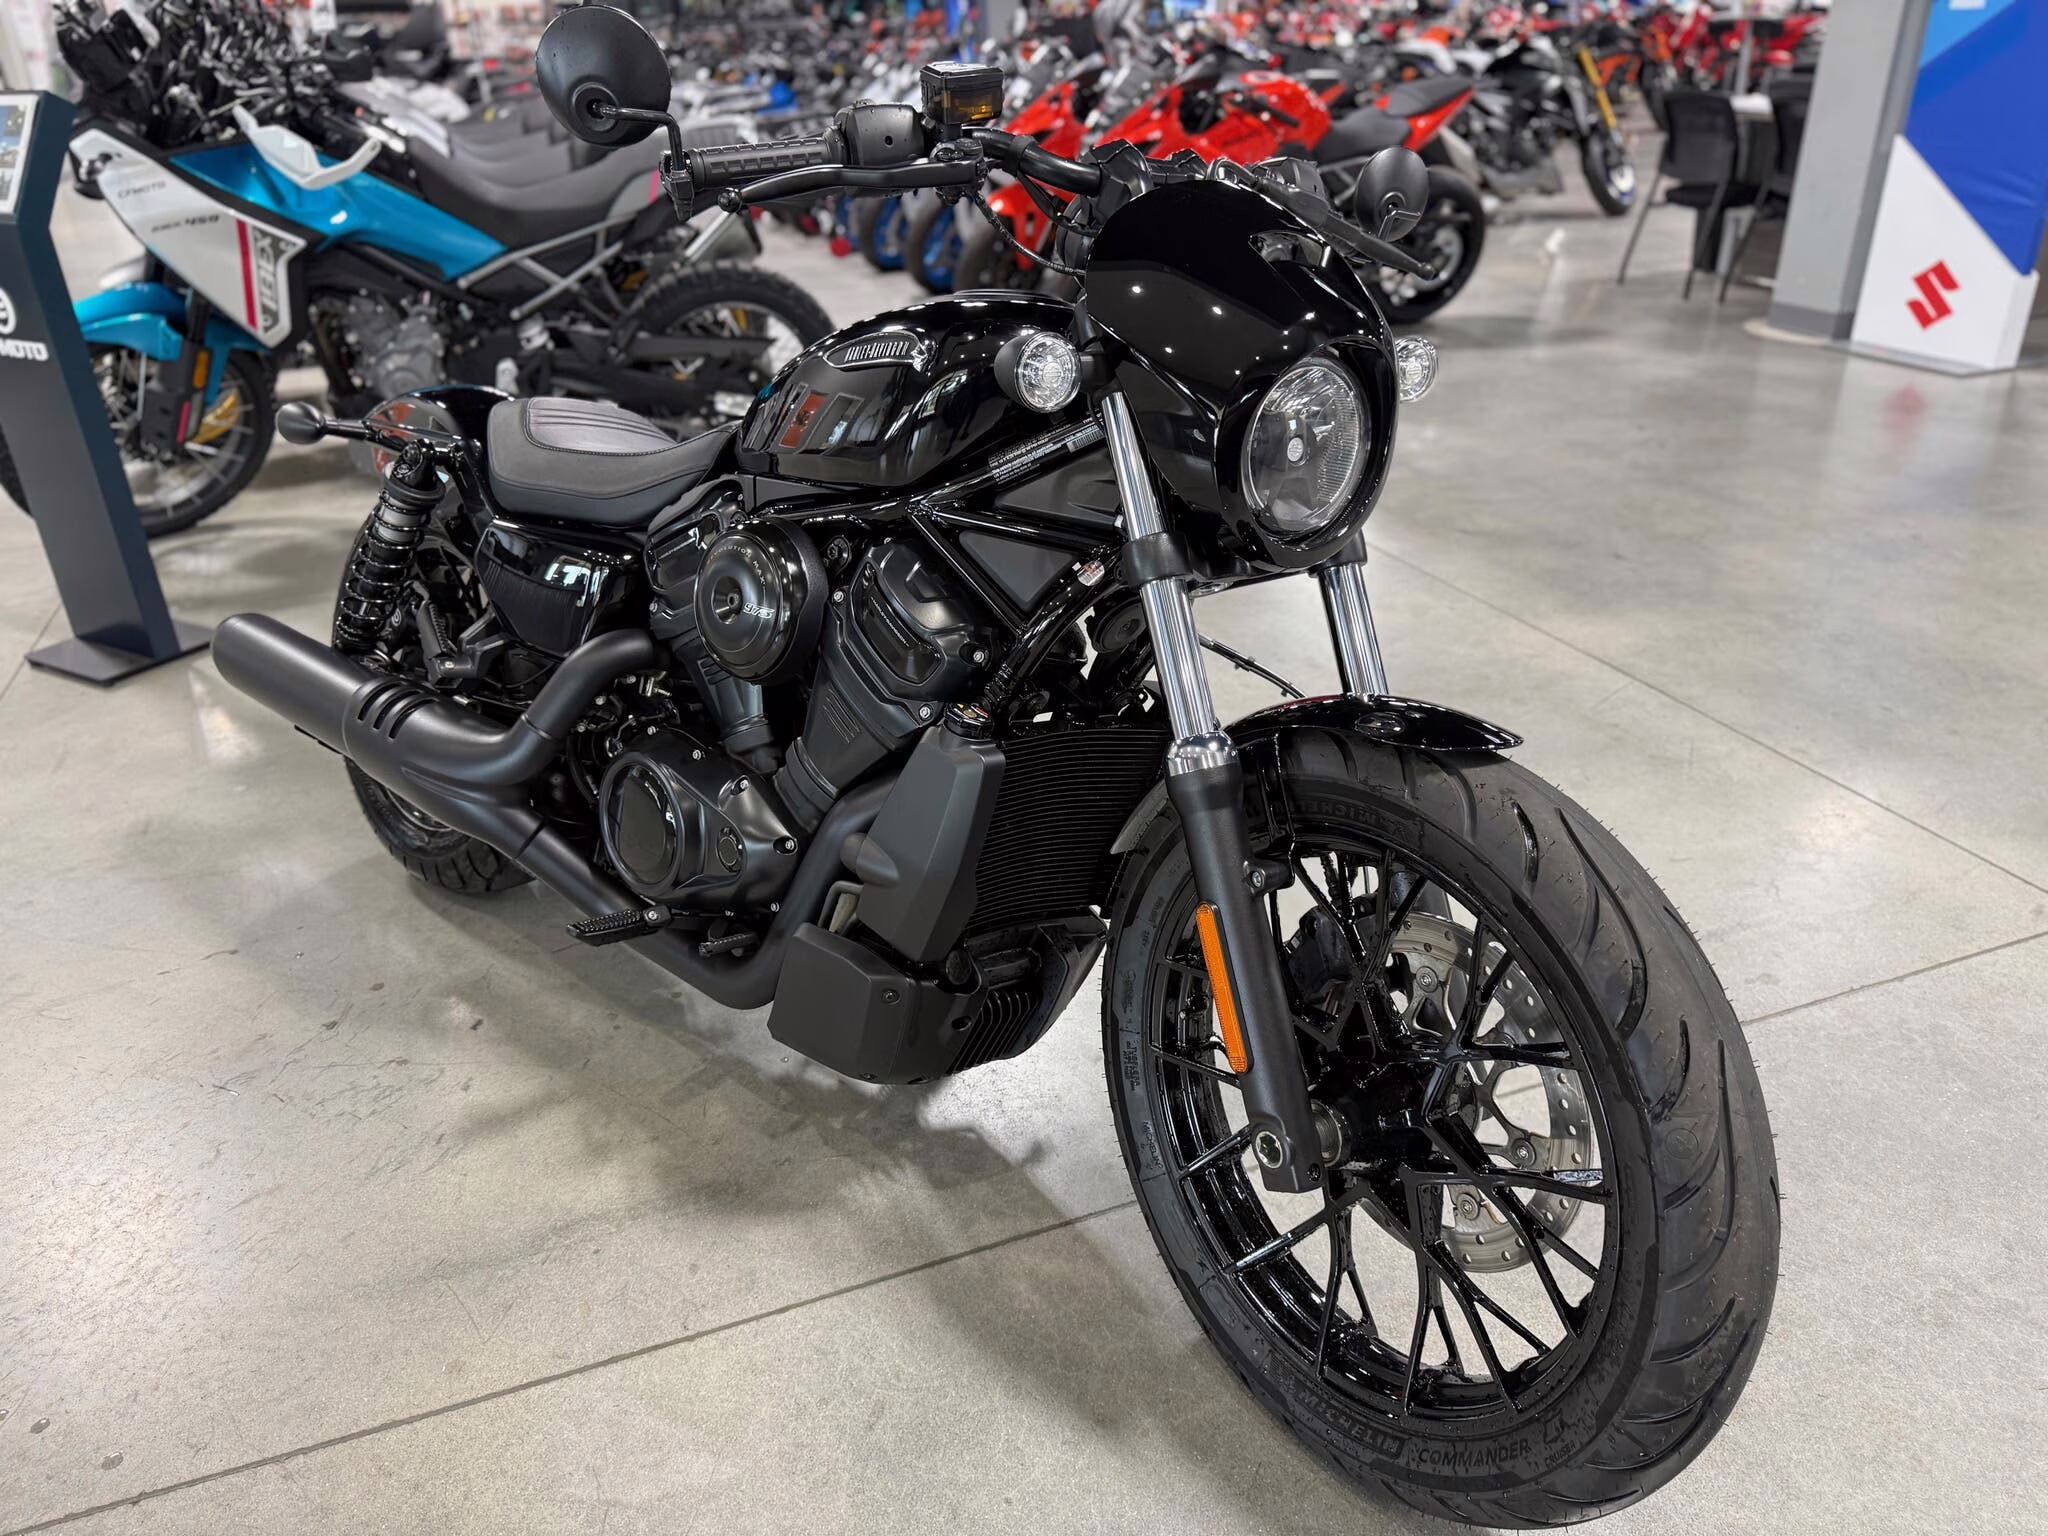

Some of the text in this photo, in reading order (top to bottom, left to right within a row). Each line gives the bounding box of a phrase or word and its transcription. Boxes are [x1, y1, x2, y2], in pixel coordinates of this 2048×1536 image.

[118, 180, 166, 199] CFMOTO
[706, 544, 752, 565] UTION
[743, 602, 776, 619] 975
[1297, 1388, 1400, 1454] MICHELIN
[1417, 1440, 1530, 1468] COMMANDER
